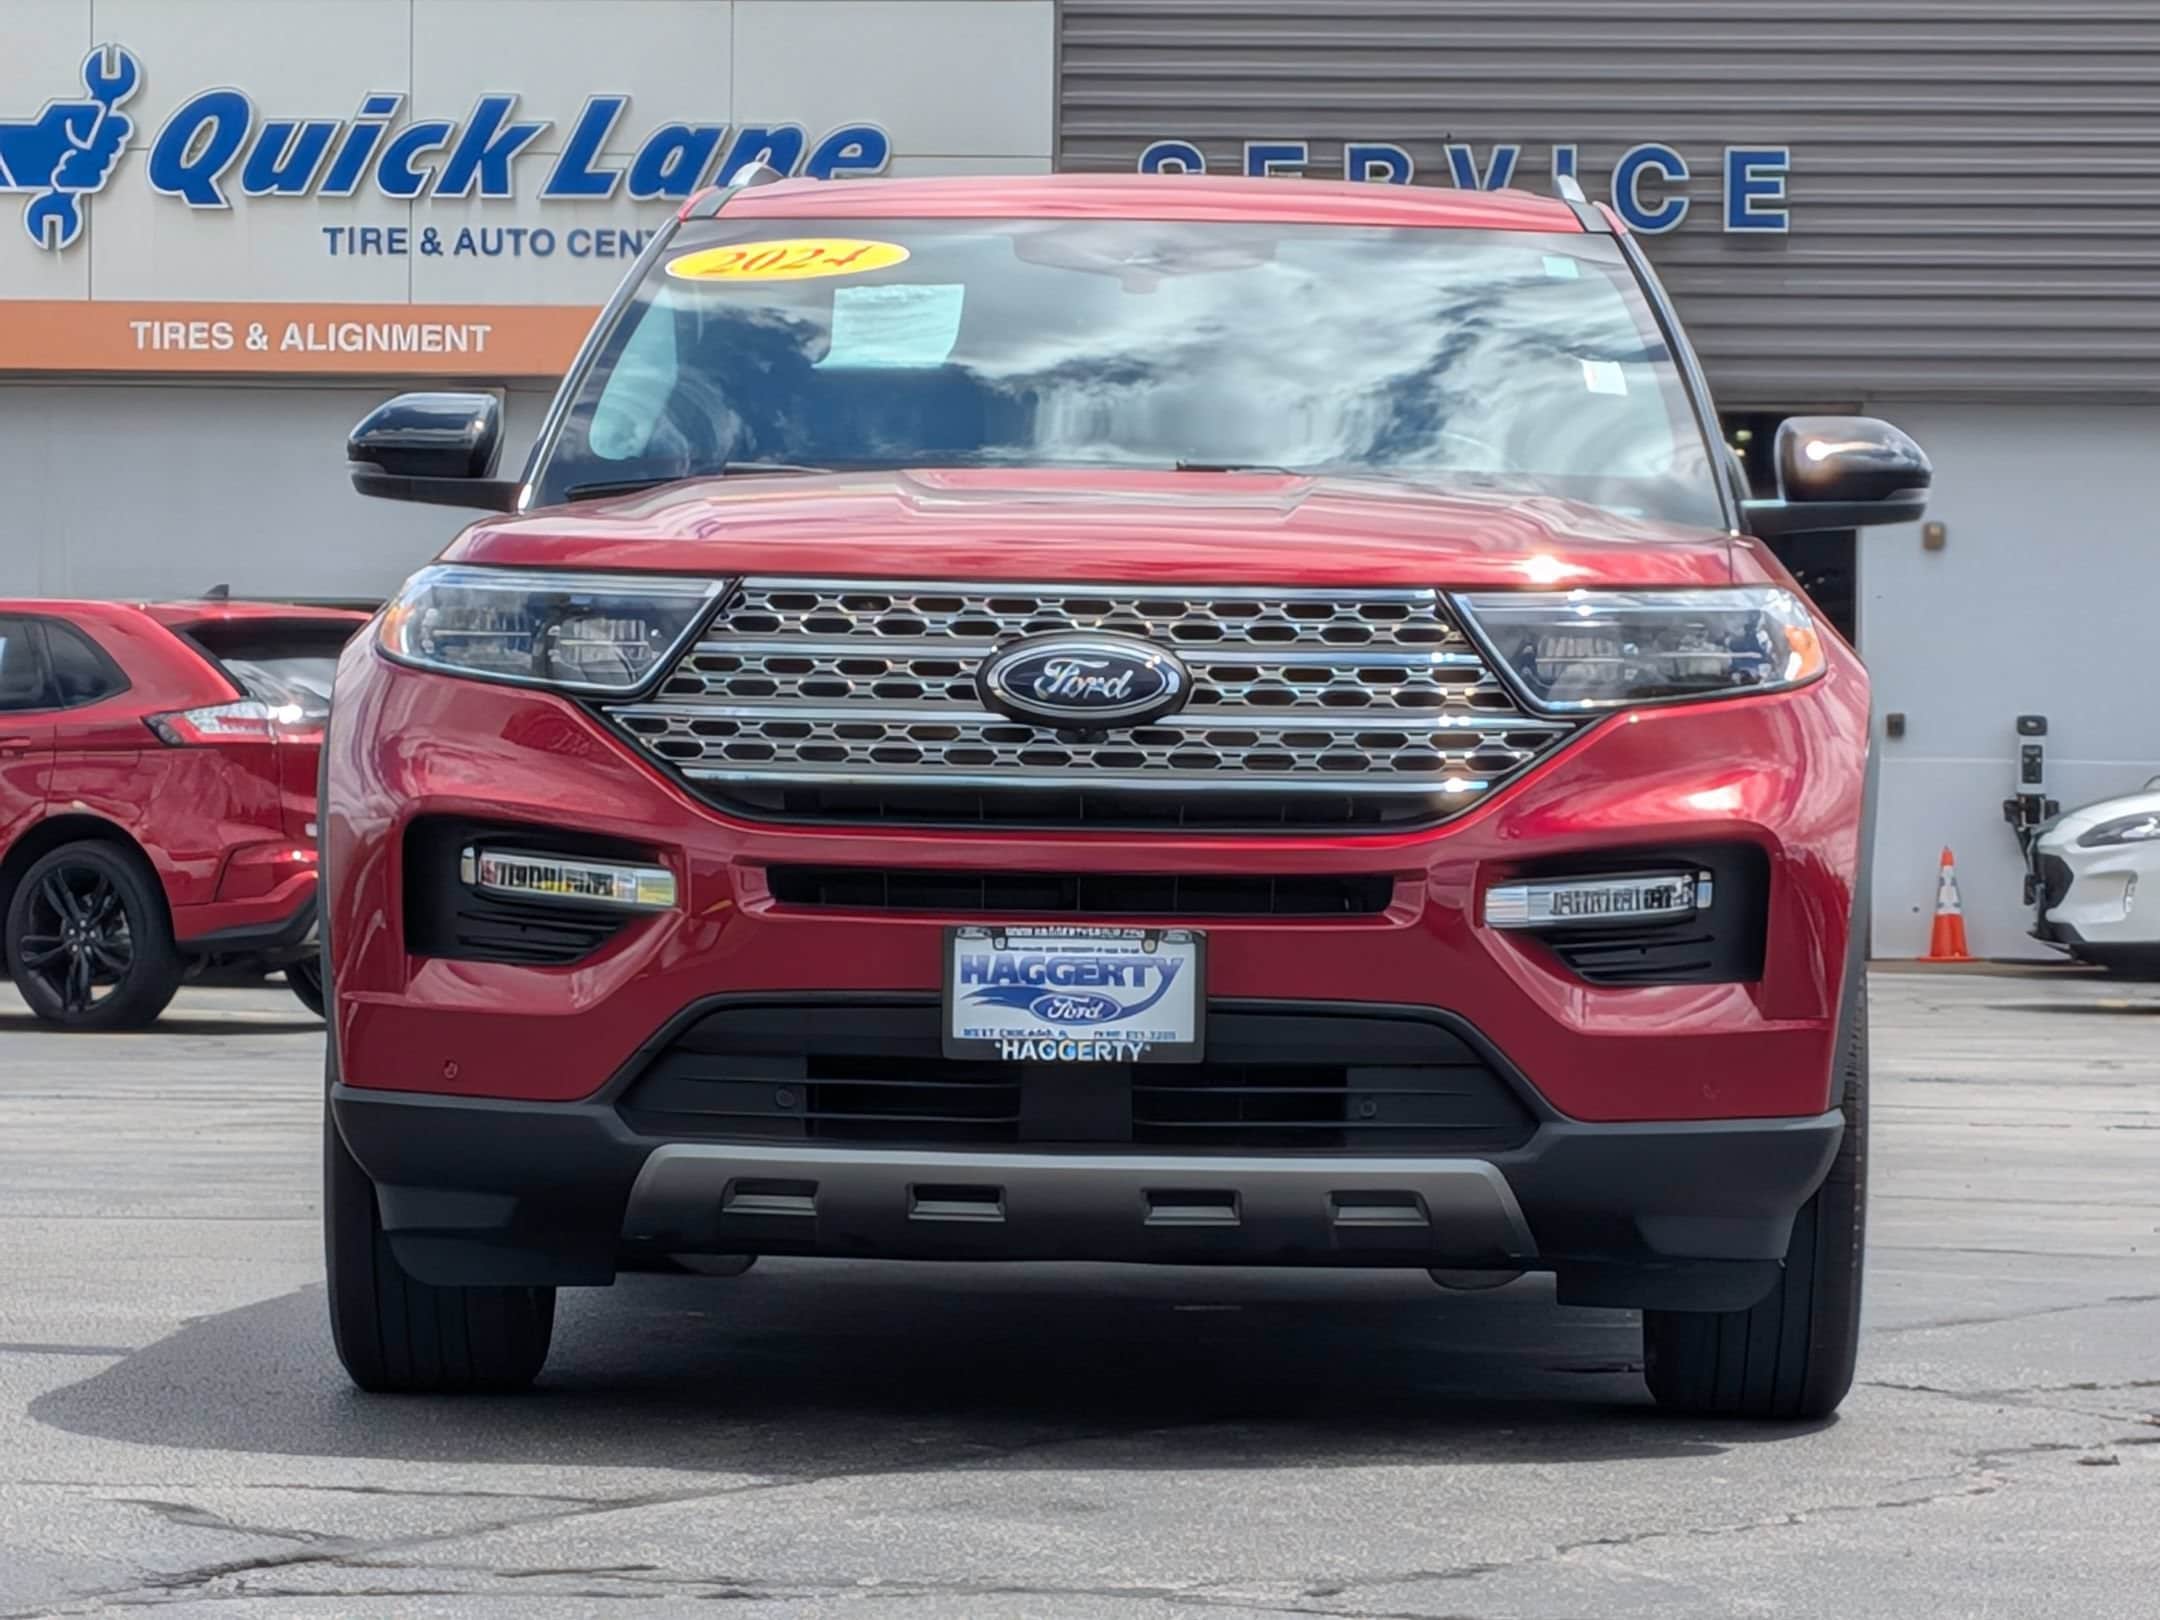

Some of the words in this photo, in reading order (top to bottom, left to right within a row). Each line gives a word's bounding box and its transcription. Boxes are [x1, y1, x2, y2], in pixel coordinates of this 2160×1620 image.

[146, 85, 550, 209] Quick
[538, 93, 893, 201] Lane
[322, 226, 408, 256] TIRE
[419, 226, 444, 257] &
[453, 227, 557, 258] AUTO
[566, 228, 660, 260] CEN
[130, 320, 234, 351] TIRES
[245, 321, 269, 352] &
[279, 321, 493, 354] ALIGNMENT
[1033, 657, 1134, 700] Ford
[960, 954, 1184, 988] HAGGERTY
[1047, 996, 1104, 1020] Ford
